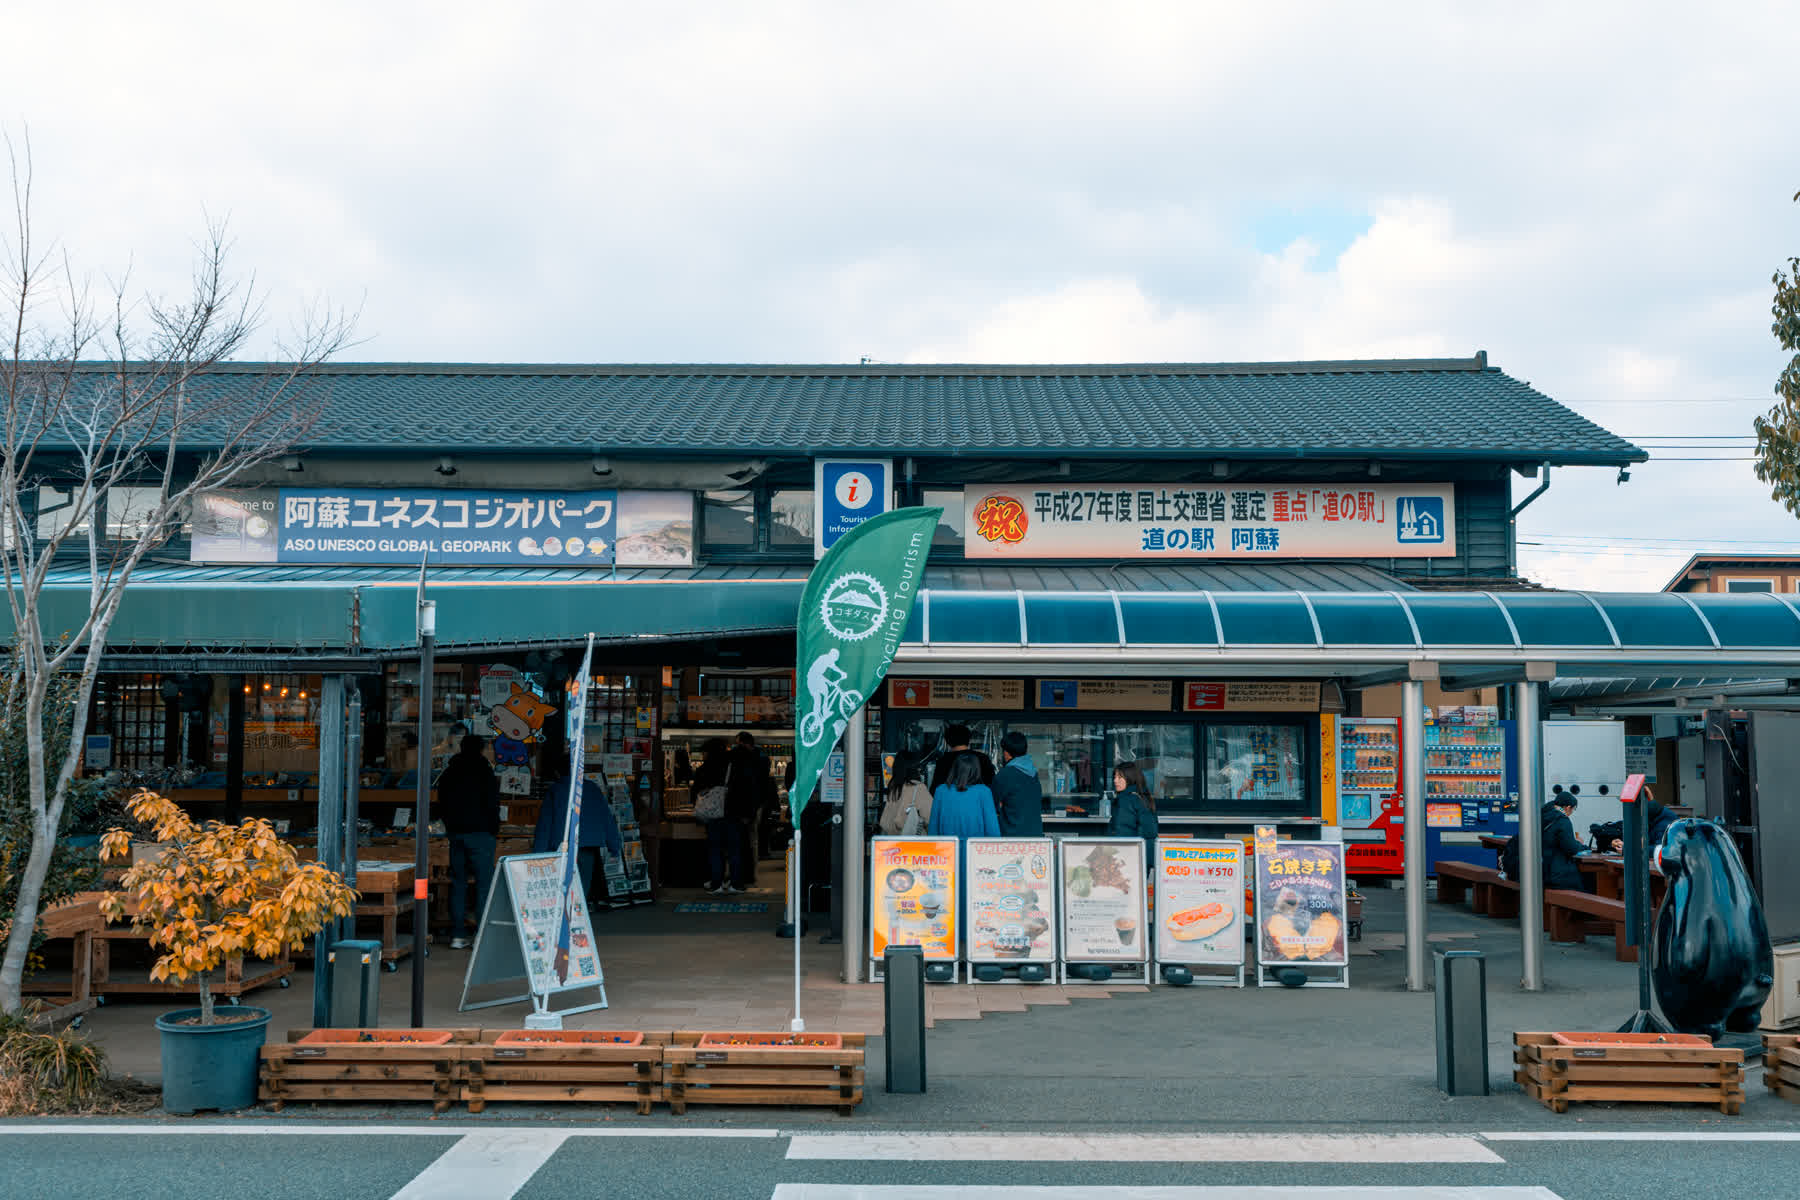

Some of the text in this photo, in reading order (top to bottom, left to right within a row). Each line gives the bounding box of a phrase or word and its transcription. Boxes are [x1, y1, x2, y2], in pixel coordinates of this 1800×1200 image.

[262, 498, 274, 511] to
[284, 496, 613, 529] 阿蘇ユネスコジオパーク
[1034, 489, 1385, 523] 平成27年度 国土交通省 選定 重点「道の駅」
[840, 515, 868, 524] Tourist
[977, 496, 1025, 543] 祝
[284, 539, 512, 553] ASO UNESCO GLOBAL GEOPARK
[1142, 527, 1280, 551] 道の駅 阿蘇
[835, 607, 871, 621] コギダス
[876, 532, 925, 680] Cycling Tourism
[885, 855, 948, 866] HOT MENU
[1268, 858, 1333, 876] 石焼き芋
[1207, 867, 1234, 877] ¥570
